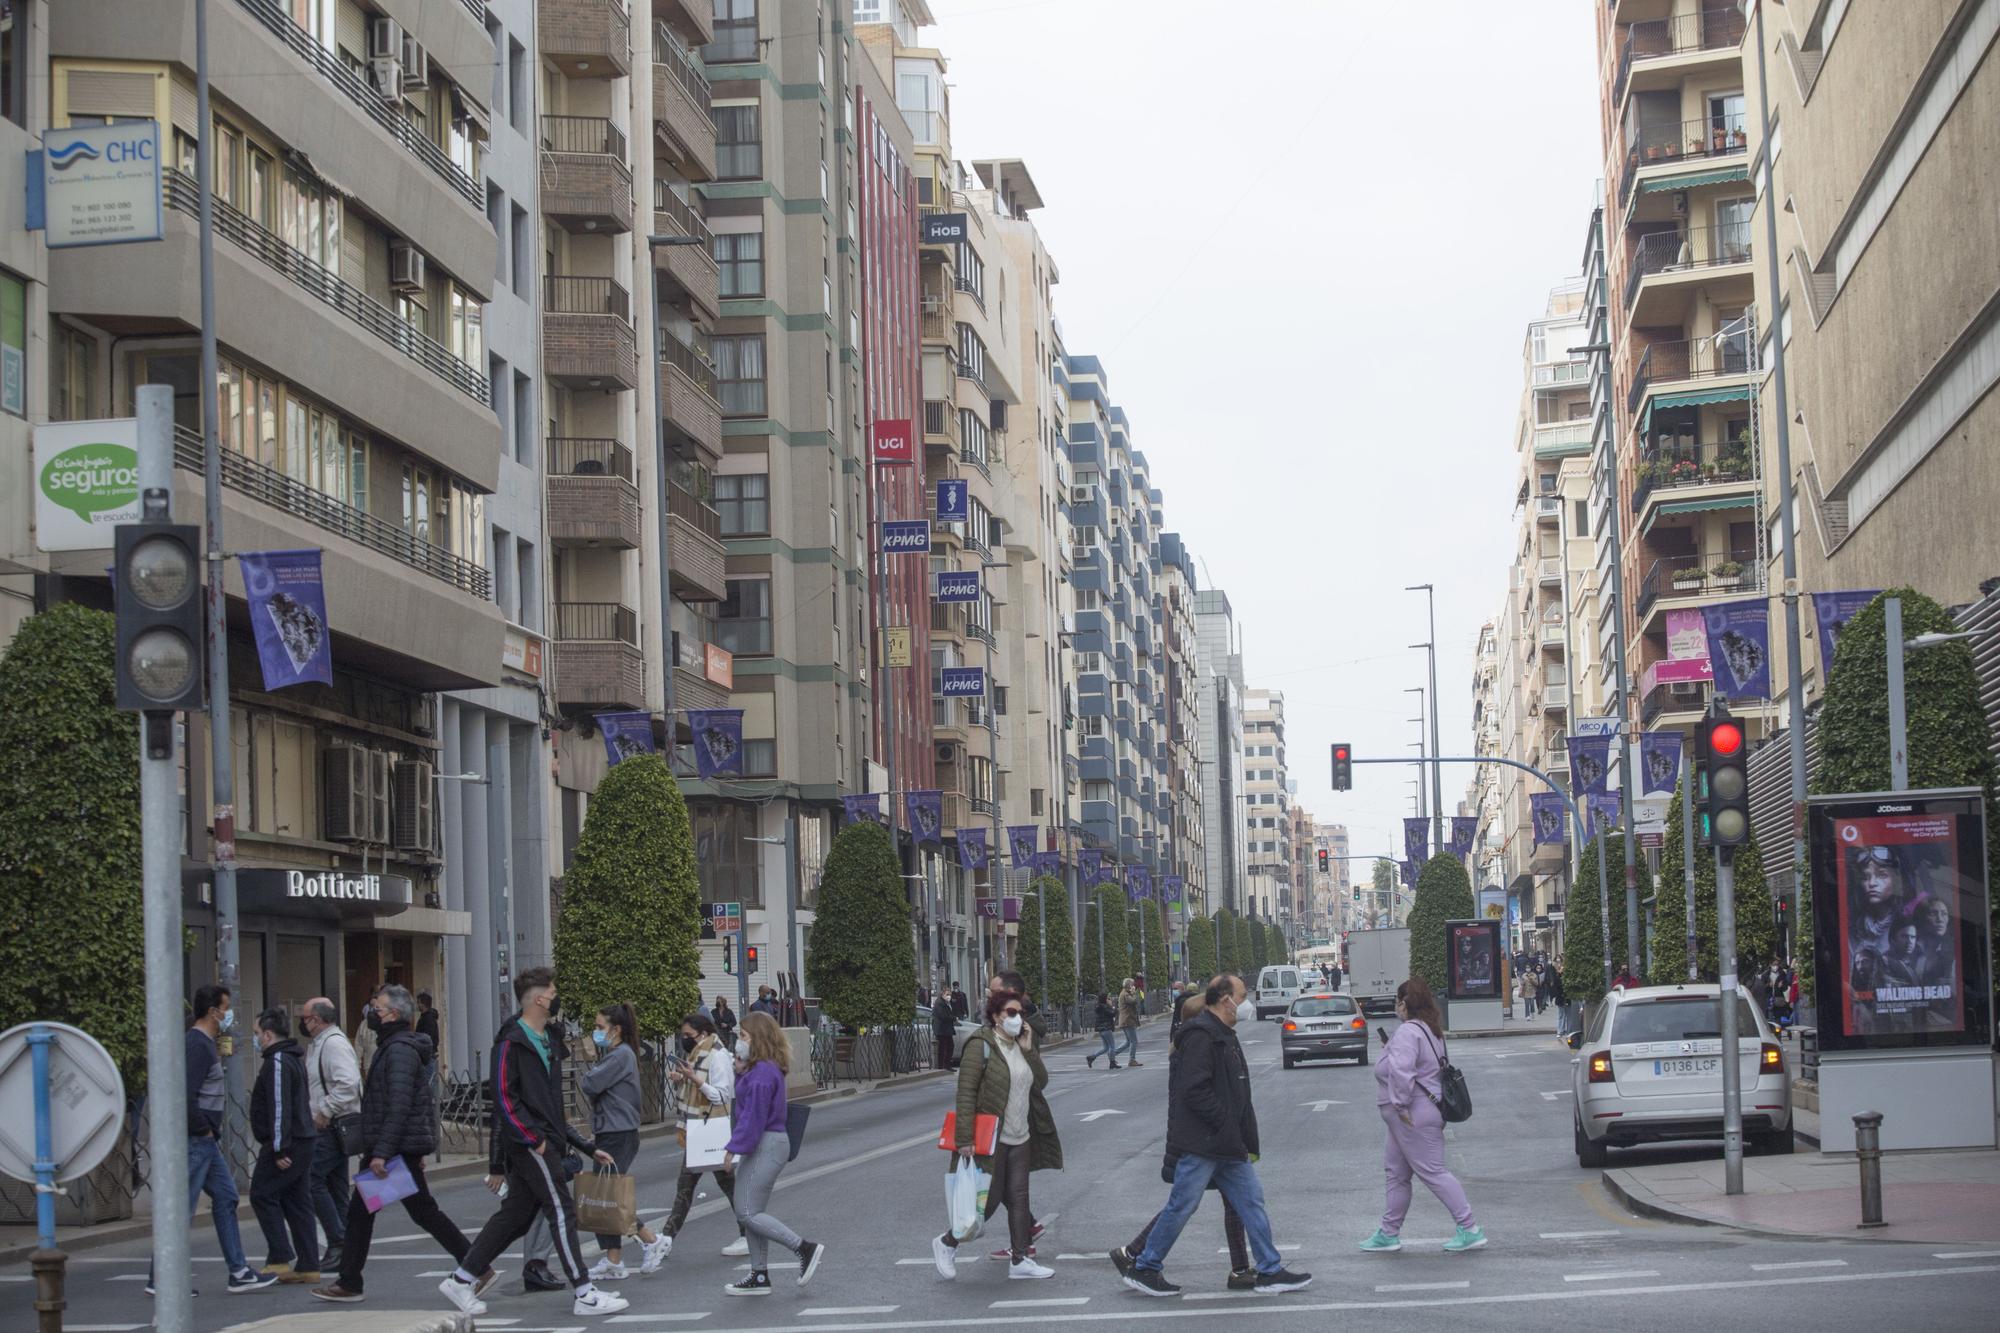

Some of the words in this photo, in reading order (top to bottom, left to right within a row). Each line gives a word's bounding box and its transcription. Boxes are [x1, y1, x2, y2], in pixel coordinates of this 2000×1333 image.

[106, 139, 153, 163] CHC
[931, 226, 961, 237] HOB
[878, 438, 904, 449] UCI
[883, 534, 926, 547] KPMG
[940, 584, 977, 596] KPMG
[944, 680, 981, 691] KPMG
[1579, 723, 1601, 731] ARCO
[286, 870, 380, 901] Botticelli
[716, 905, 724, 916] P
[1876, 985, 1922, 1001] WALKING
[1924, 985, 1952, 1000] DEAD
[1663, 1061, 1692, 1072] 0136
